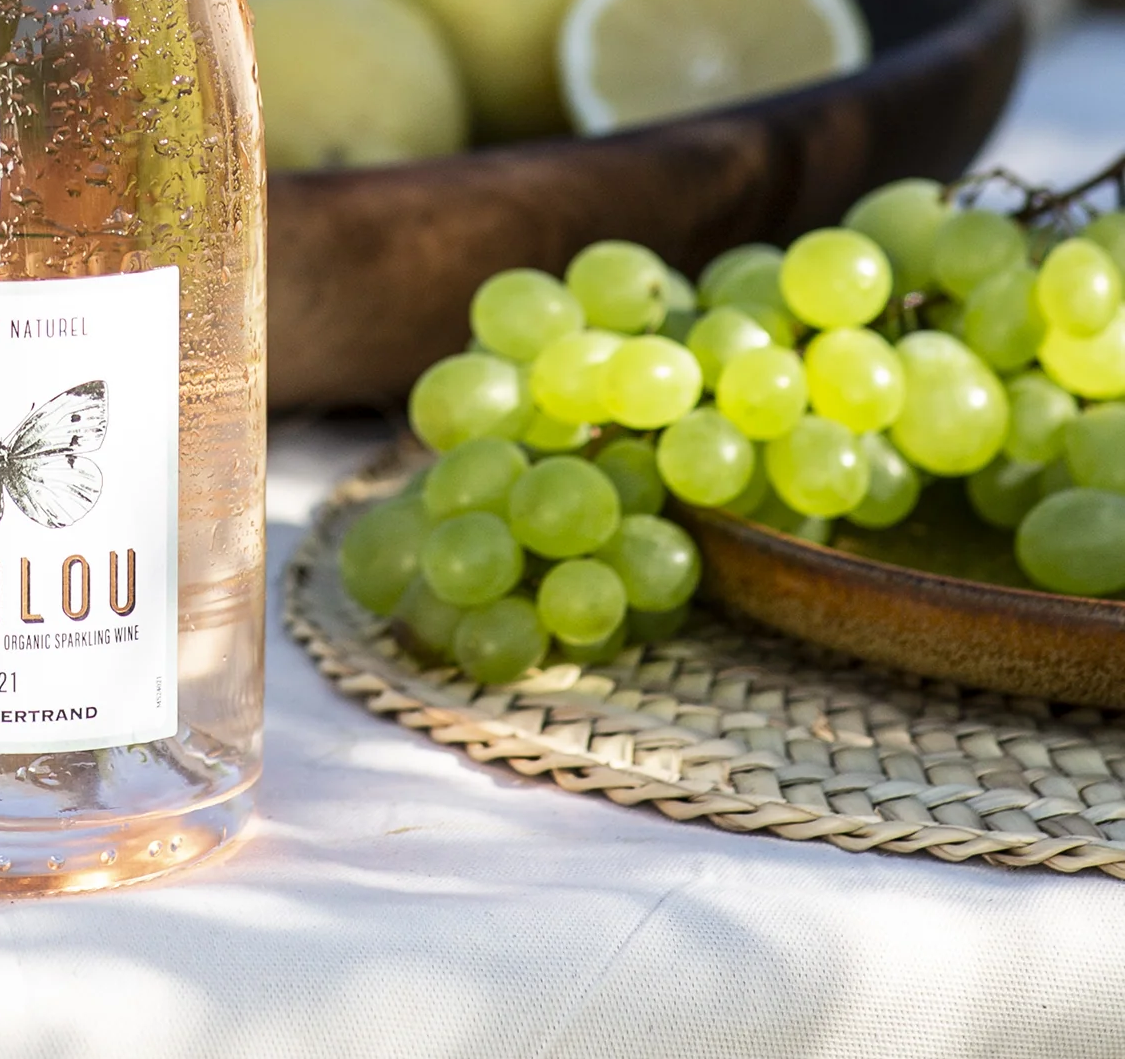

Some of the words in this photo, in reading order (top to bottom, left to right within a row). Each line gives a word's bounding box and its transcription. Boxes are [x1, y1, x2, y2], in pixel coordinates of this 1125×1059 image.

[10, 316, 88, 339] NATUREL
[3, 634, 51, 651] ORGANIC
[54, 628, 111, 650] SPARKLING
[113, 624, 139, 644] WINE
